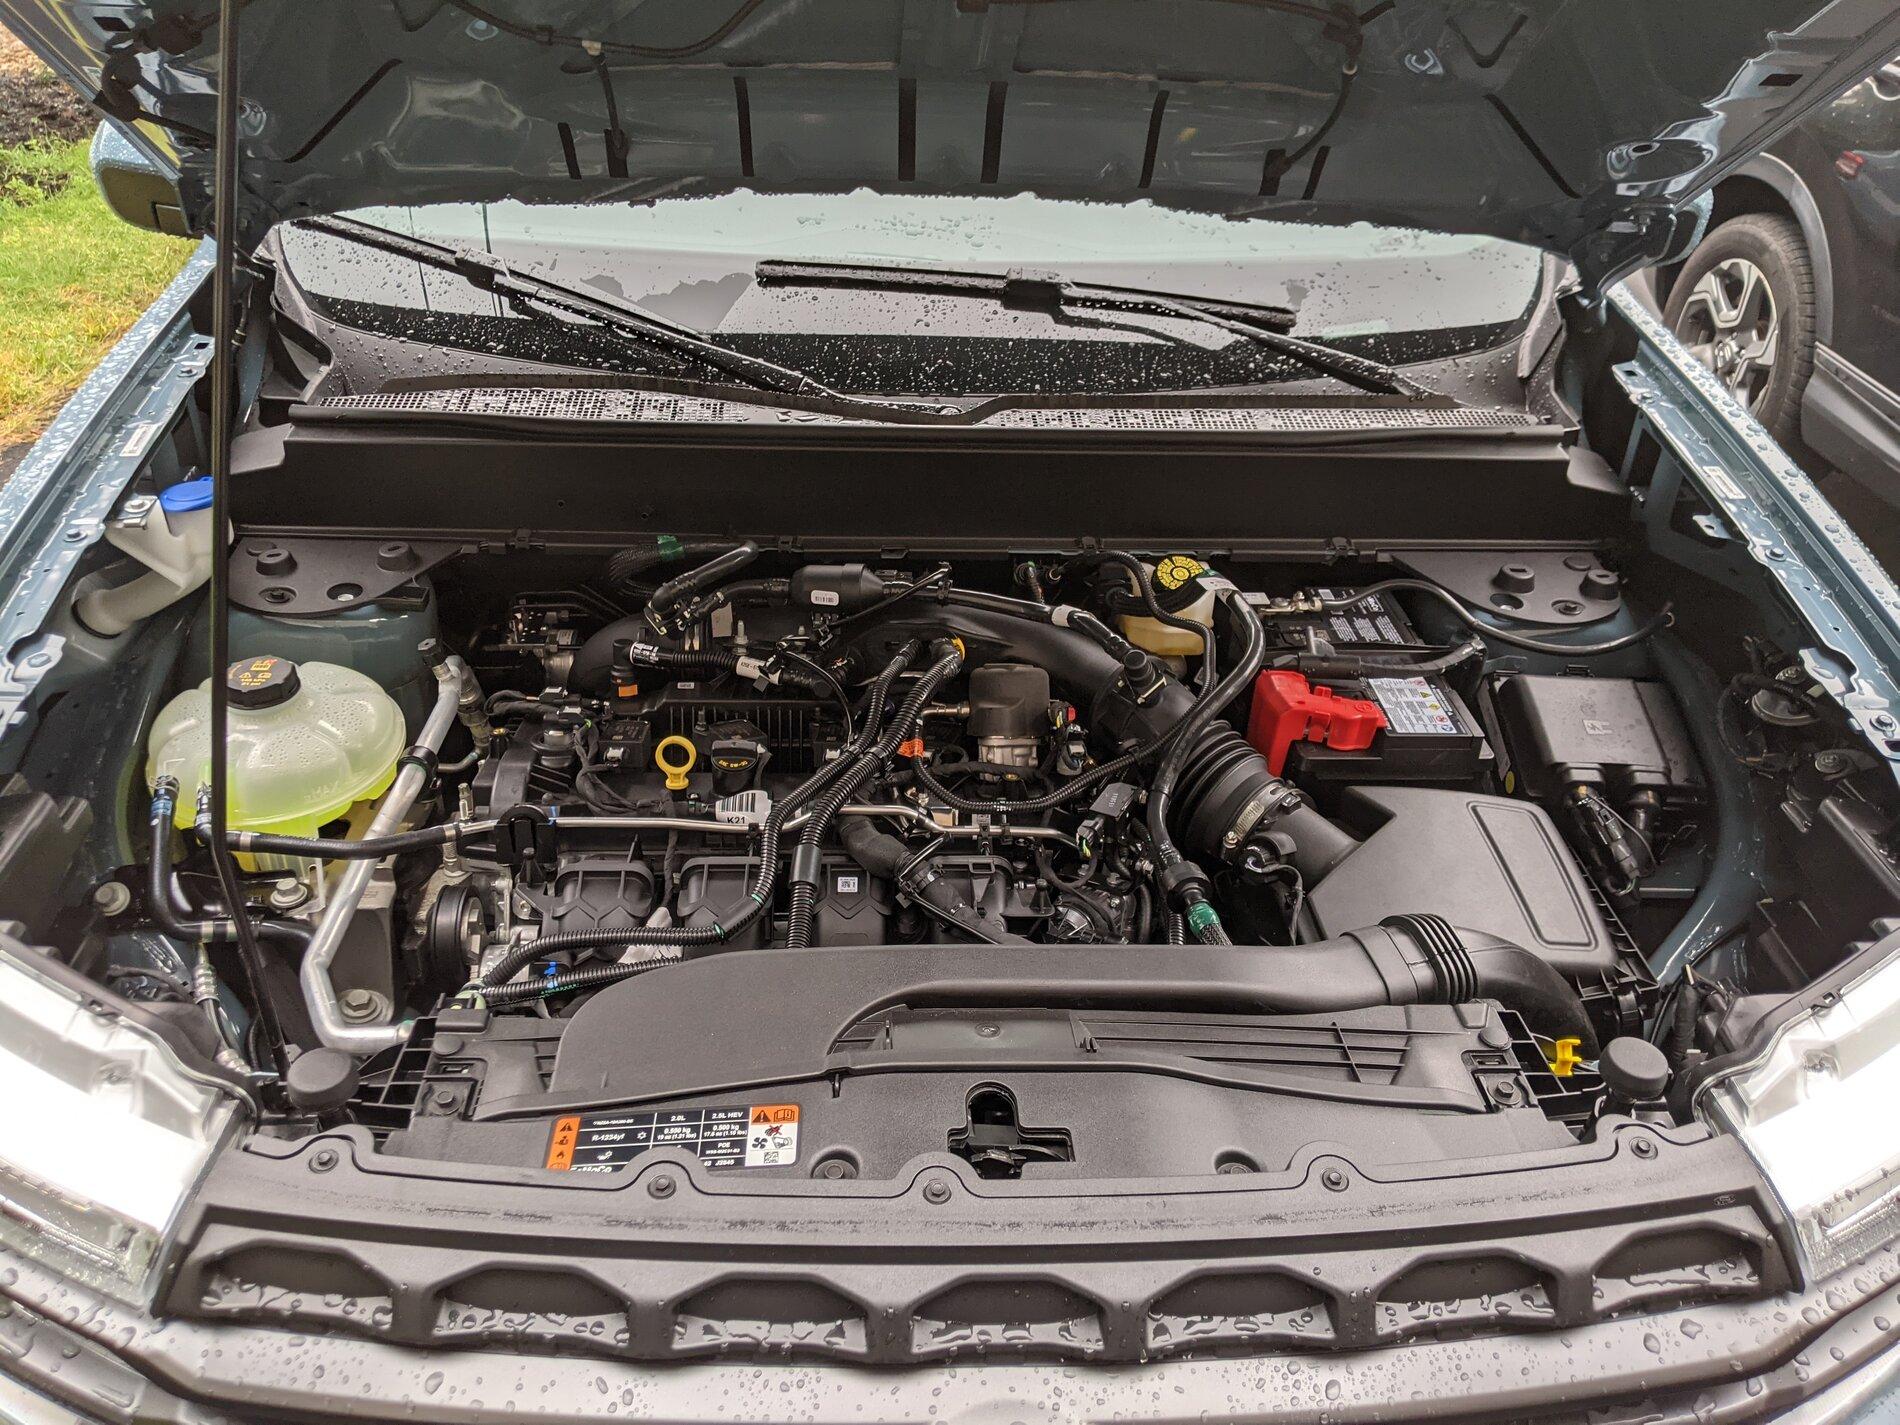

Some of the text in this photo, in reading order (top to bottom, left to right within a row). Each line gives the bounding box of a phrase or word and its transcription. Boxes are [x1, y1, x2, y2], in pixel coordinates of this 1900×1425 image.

[727, 1111, 744, 1119] HEV
[682, 1126, 691, 1134] kg
[591, 1132, 626, 1143] R-1234yf
